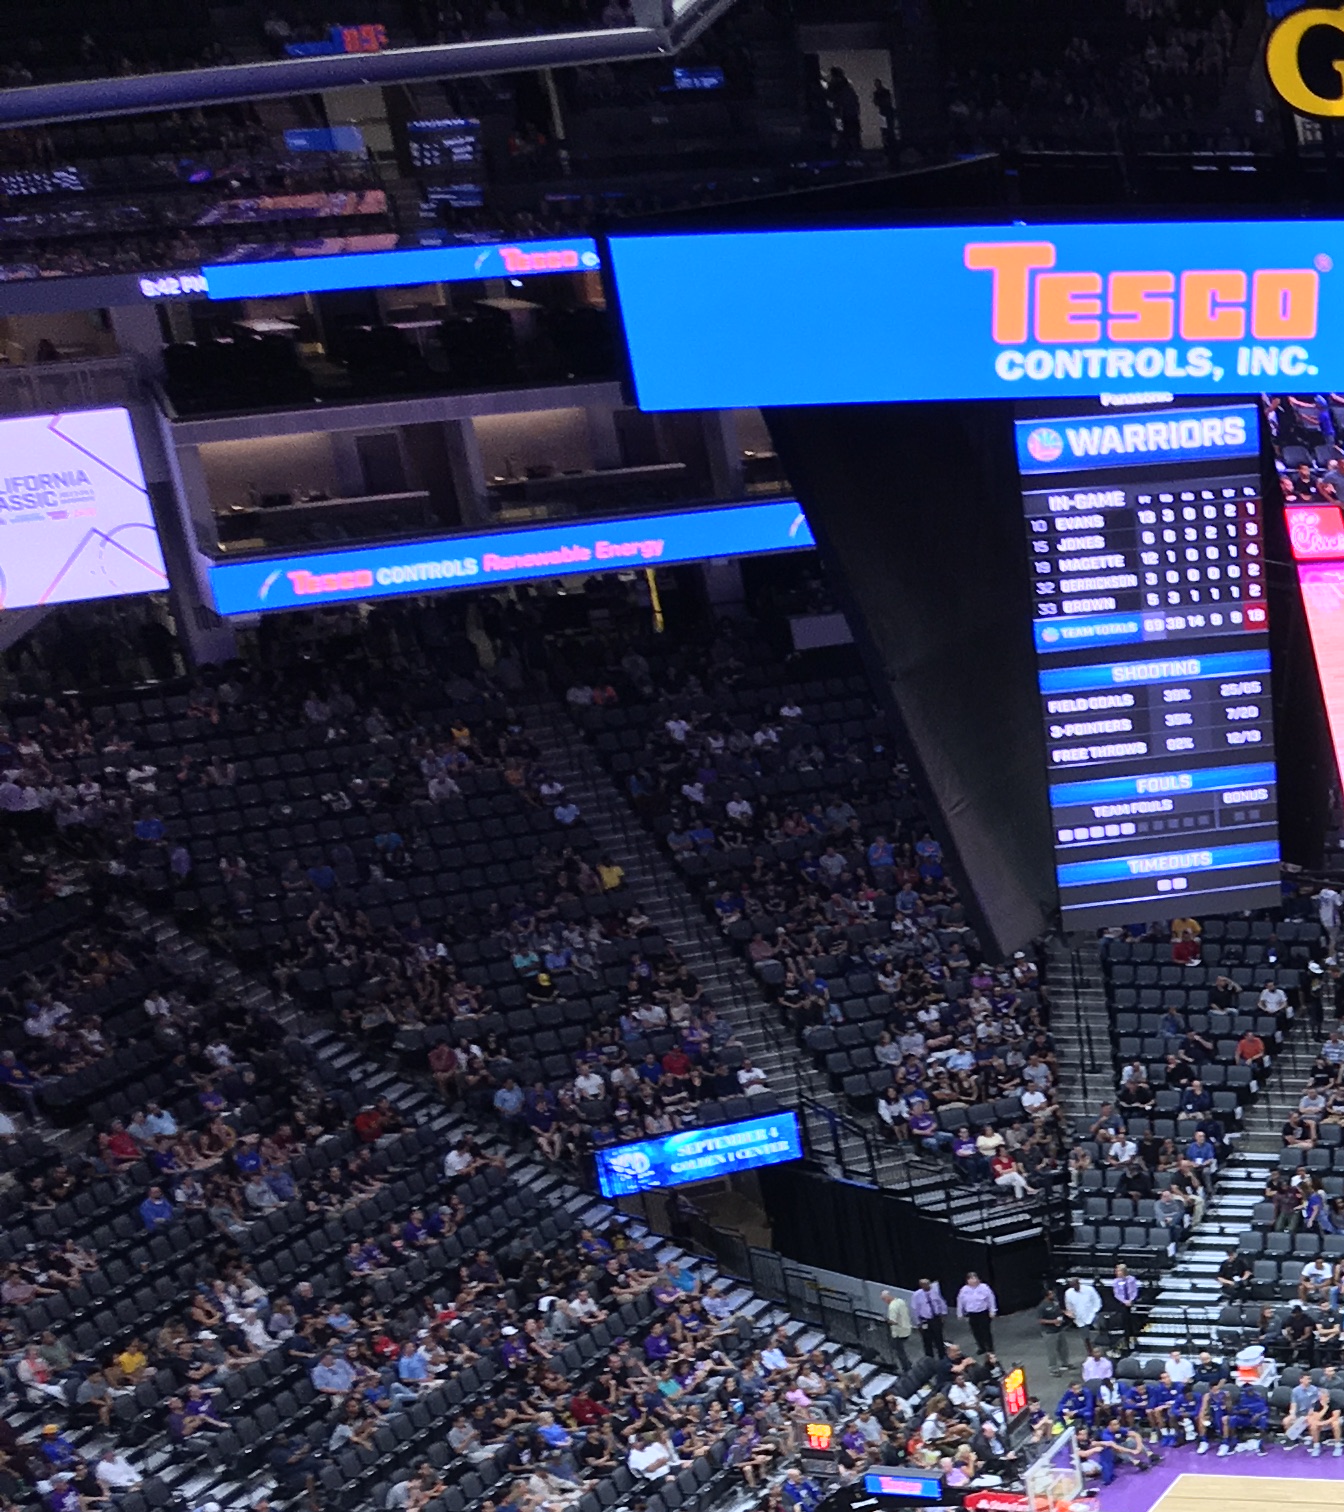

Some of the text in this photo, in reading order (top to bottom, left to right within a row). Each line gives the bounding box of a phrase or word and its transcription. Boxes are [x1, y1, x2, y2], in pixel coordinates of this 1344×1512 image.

[964, 241, 1319, 345] TESCO
[995, 345, 1319, 382] CONTROLS, INC.
[1065, 416, 1247, 457] WARRIORS
[1048, 490, 1126, 511] IN-GAME
[1030, 510, 1156, 533] 10 EVANS 13
[1032, 535, 1105, 554] 15 JONES
[377, 557, 477, 585] CONTROLS
[482, 546, 591, 572] Renewable
[595, 538, 664, 562] Energy
[1058, 554, 1125, 573] MAGETTE
[1140, 552, 1159, 566] 12
[1060, 574, 1138, 593] DERRICKSON
[1061, 597, 1116, 614] BROWN
[1143, 617, 1165, 632] 69
[1112, 659, 1201, 682] SHOOTING
[1088, 694, 1134, 711] GOALS
[1050, 705, 1259, 738] 3-POINTERS 35% 7/20
[1052, 747, 1089, 763] FREE
[1090, 742, 1148, 759] THROWS
[1226, 730, 1262, 744] 12/13
[1136, 774, 1193, 794] FOULS
[1092, 788, 1268, 818] TEAM FOULS BONUS
[1127, 851, 1213, 874] TIMEOUTS
[676, 1128, 766, 1157] SEPTEMBER
